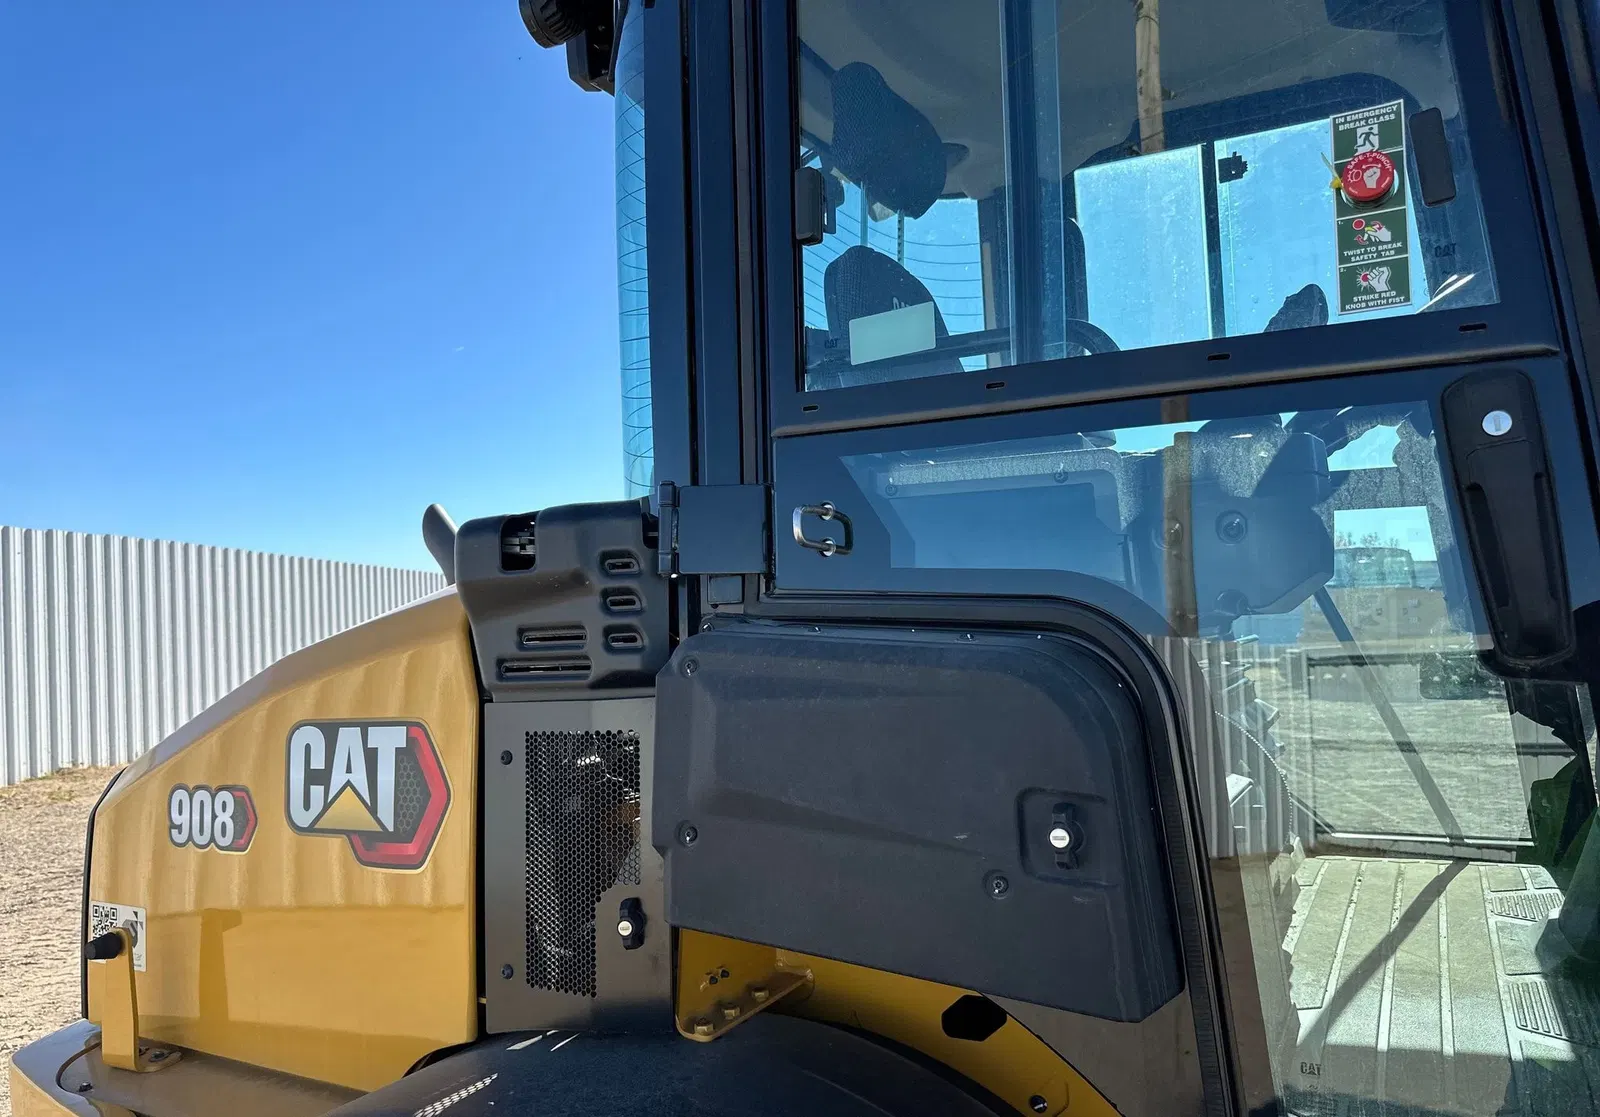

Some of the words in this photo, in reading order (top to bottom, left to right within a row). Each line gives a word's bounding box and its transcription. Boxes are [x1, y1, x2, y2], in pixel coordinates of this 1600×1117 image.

[1347, 105, 1399, 122] EMERGENCY
[1338, 120, 1367, 131] BREAK
[1368, 113, 1396, 125] GLASS
[1343, 248, 1365, 257] TWIST
[1378, 242, 1403, 251] BREAK
[1350, 253, 1377, 262] SAFETY
[1345, 302, 1366, 311] KNOB
[1368, 299, 1387, 308] WITH
[1388, 296, 1405, 304] FIST
[1353, 293, 1380, 303] STRIKE
[1381, 290, 1397, 298] RED
[289, 725, 407, 833] CAT
[170, 788, 236, 848] 908
[1300, 1061, 1322, 1076] CAT
